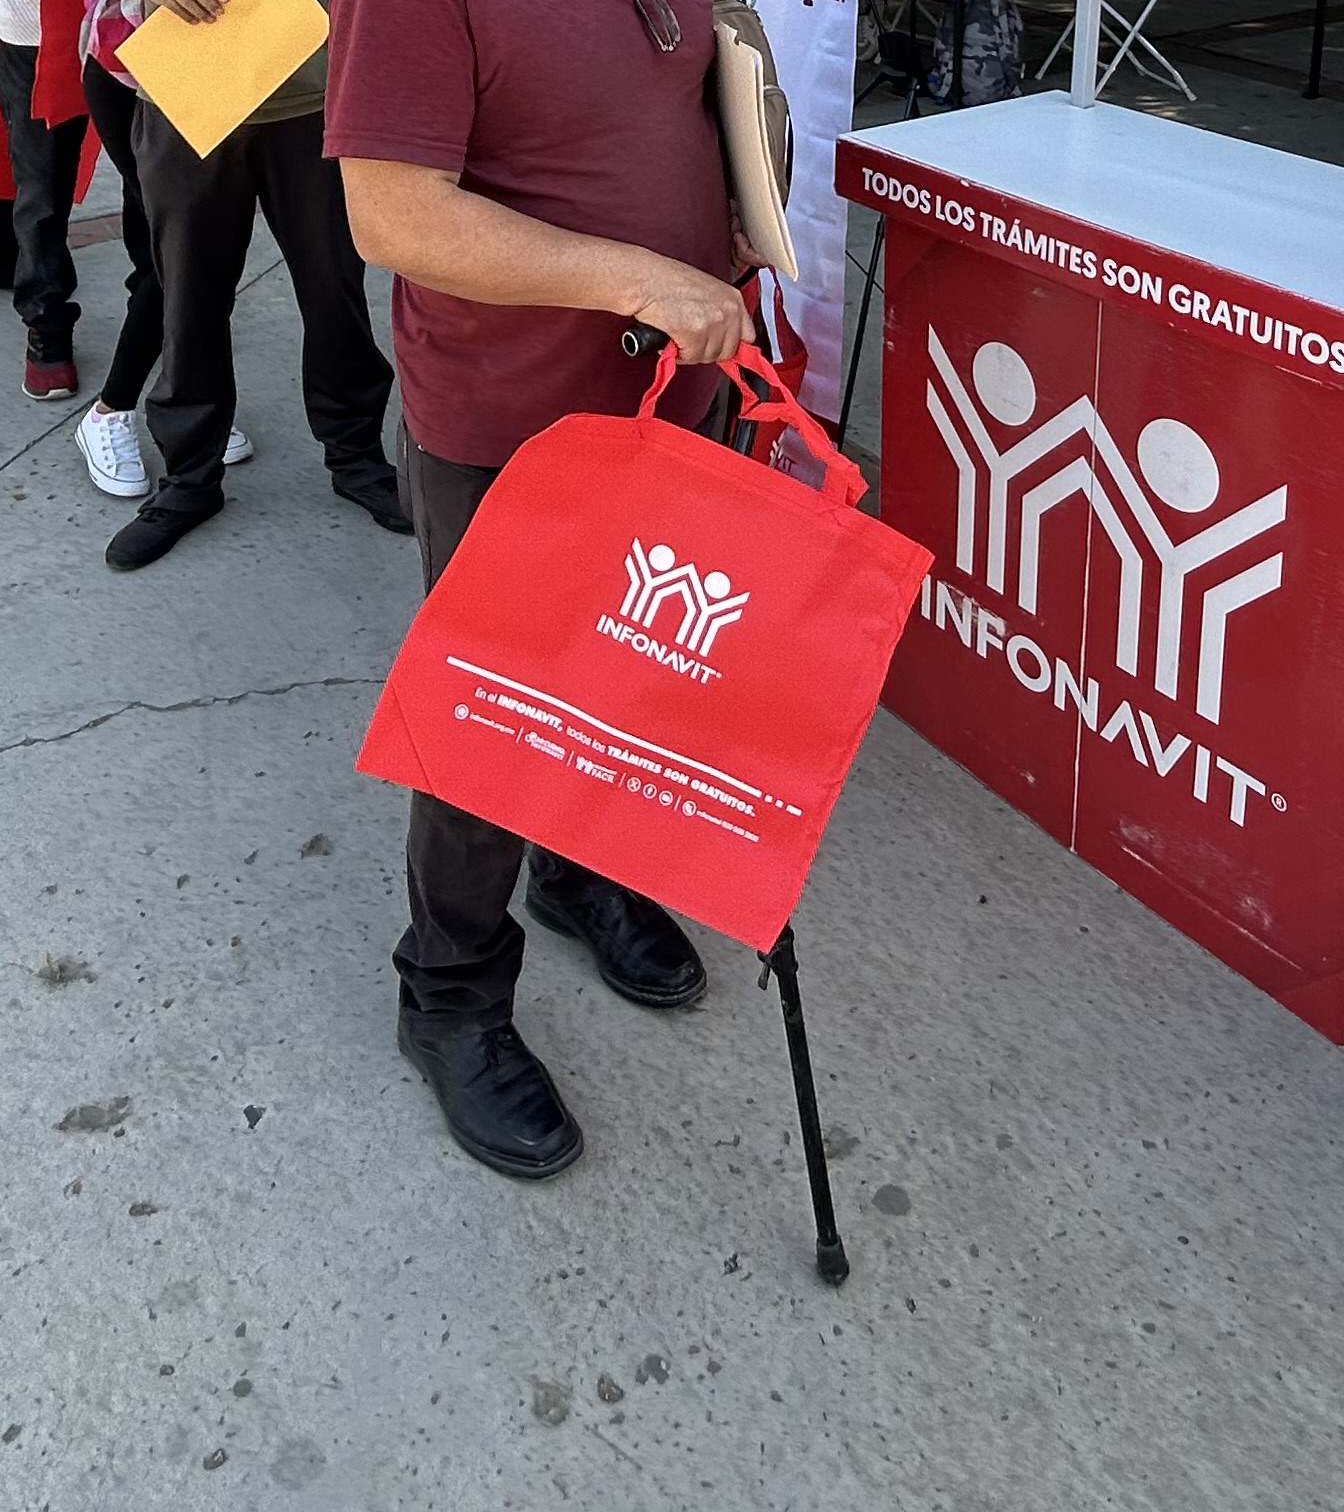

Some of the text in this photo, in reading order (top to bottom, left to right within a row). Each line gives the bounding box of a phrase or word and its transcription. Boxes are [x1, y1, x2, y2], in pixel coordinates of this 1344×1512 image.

[862, 167, 930, 215] TODOS
[935, 199, 975, 232] LOS
[979, 211, 1096, 278] TRÁMITES
[1102, 260, 1162, 303] SON
[596, 613, 717, 684] INFONAVIT
[497, 694, 564, 732] INFONAVIT,
[566, 725, 592, 746] todos
[592, 739, 606, 753] los
[663, 768, 690, 786] SON
[690, 779, 756, 817] GRATUITOS.
